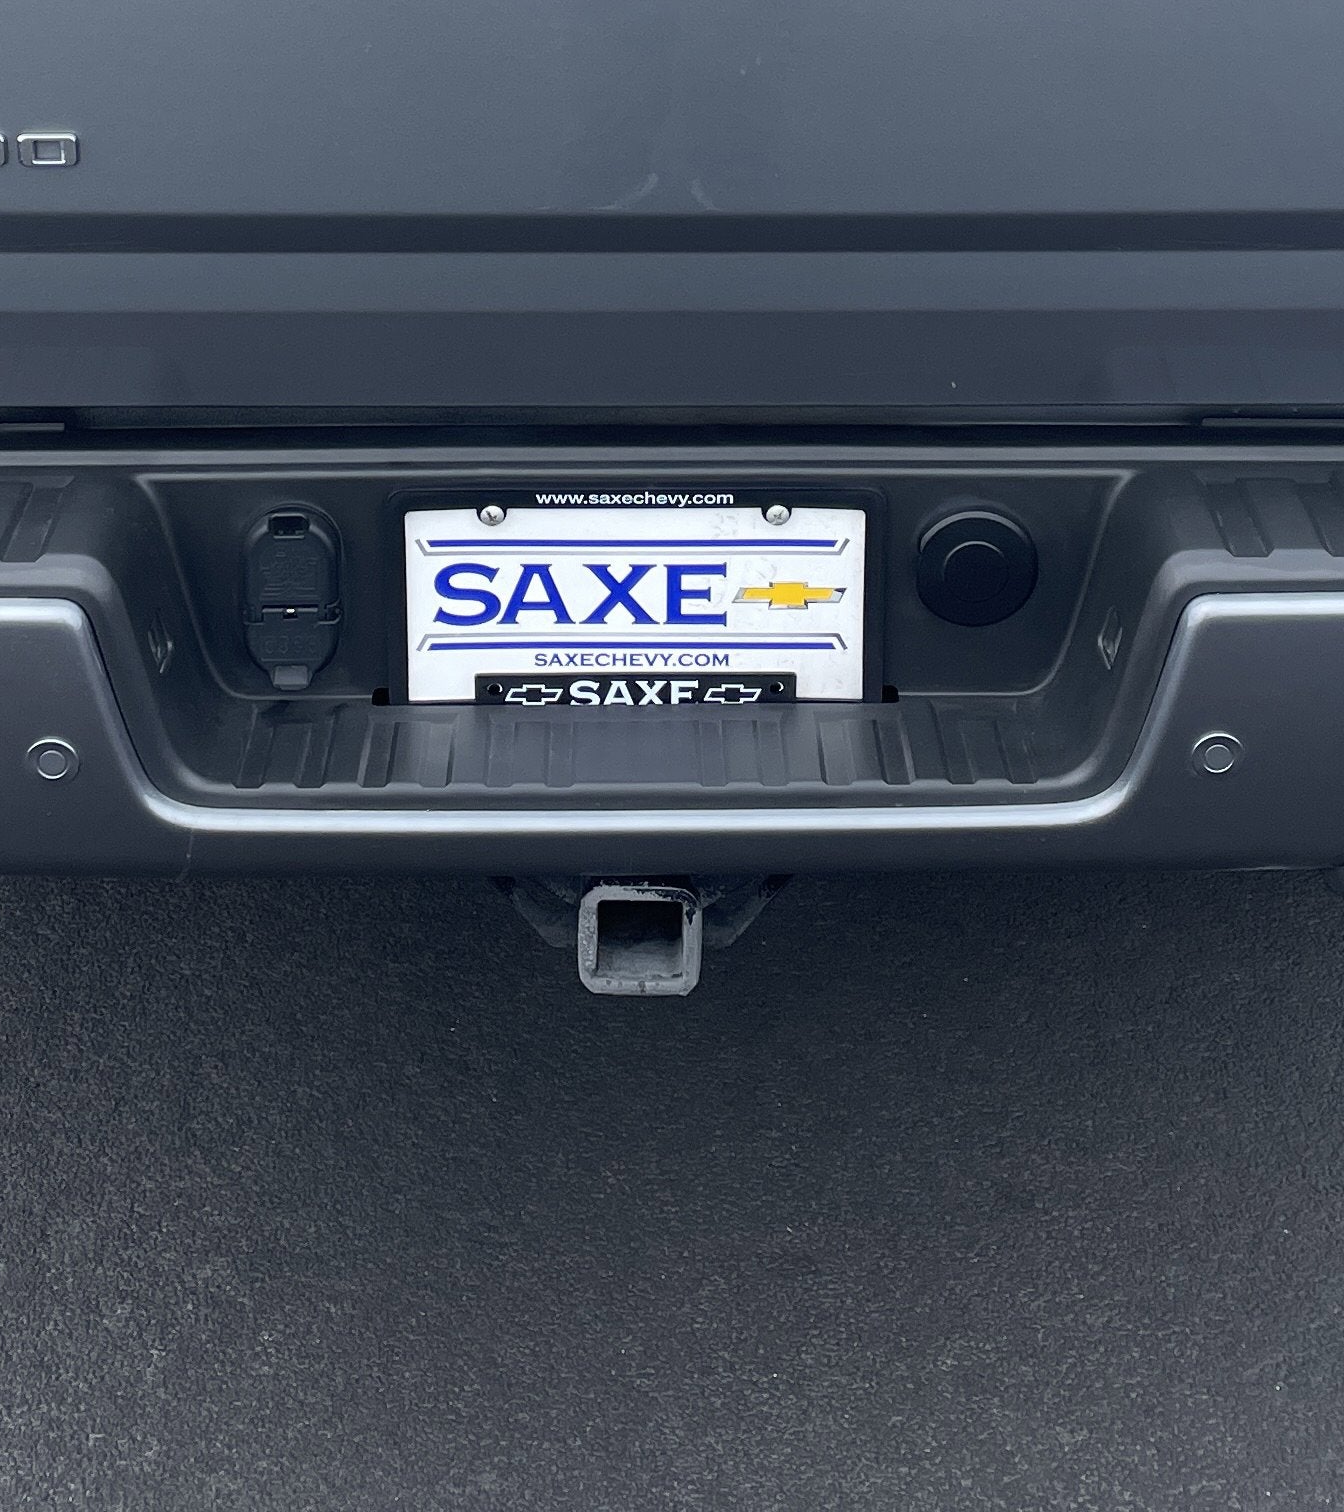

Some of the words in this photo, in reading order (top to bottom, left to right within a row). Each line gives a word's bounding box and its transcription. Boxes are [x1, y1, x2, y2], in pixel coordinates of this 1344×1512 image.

[535, 491, 735, 507] www.saxechevy.com
[433, 562, 728, 627] SAXE
[534, 652, 731, 668] SAXECHEVY.COM
[568, 679, 700, 706] SAXE
